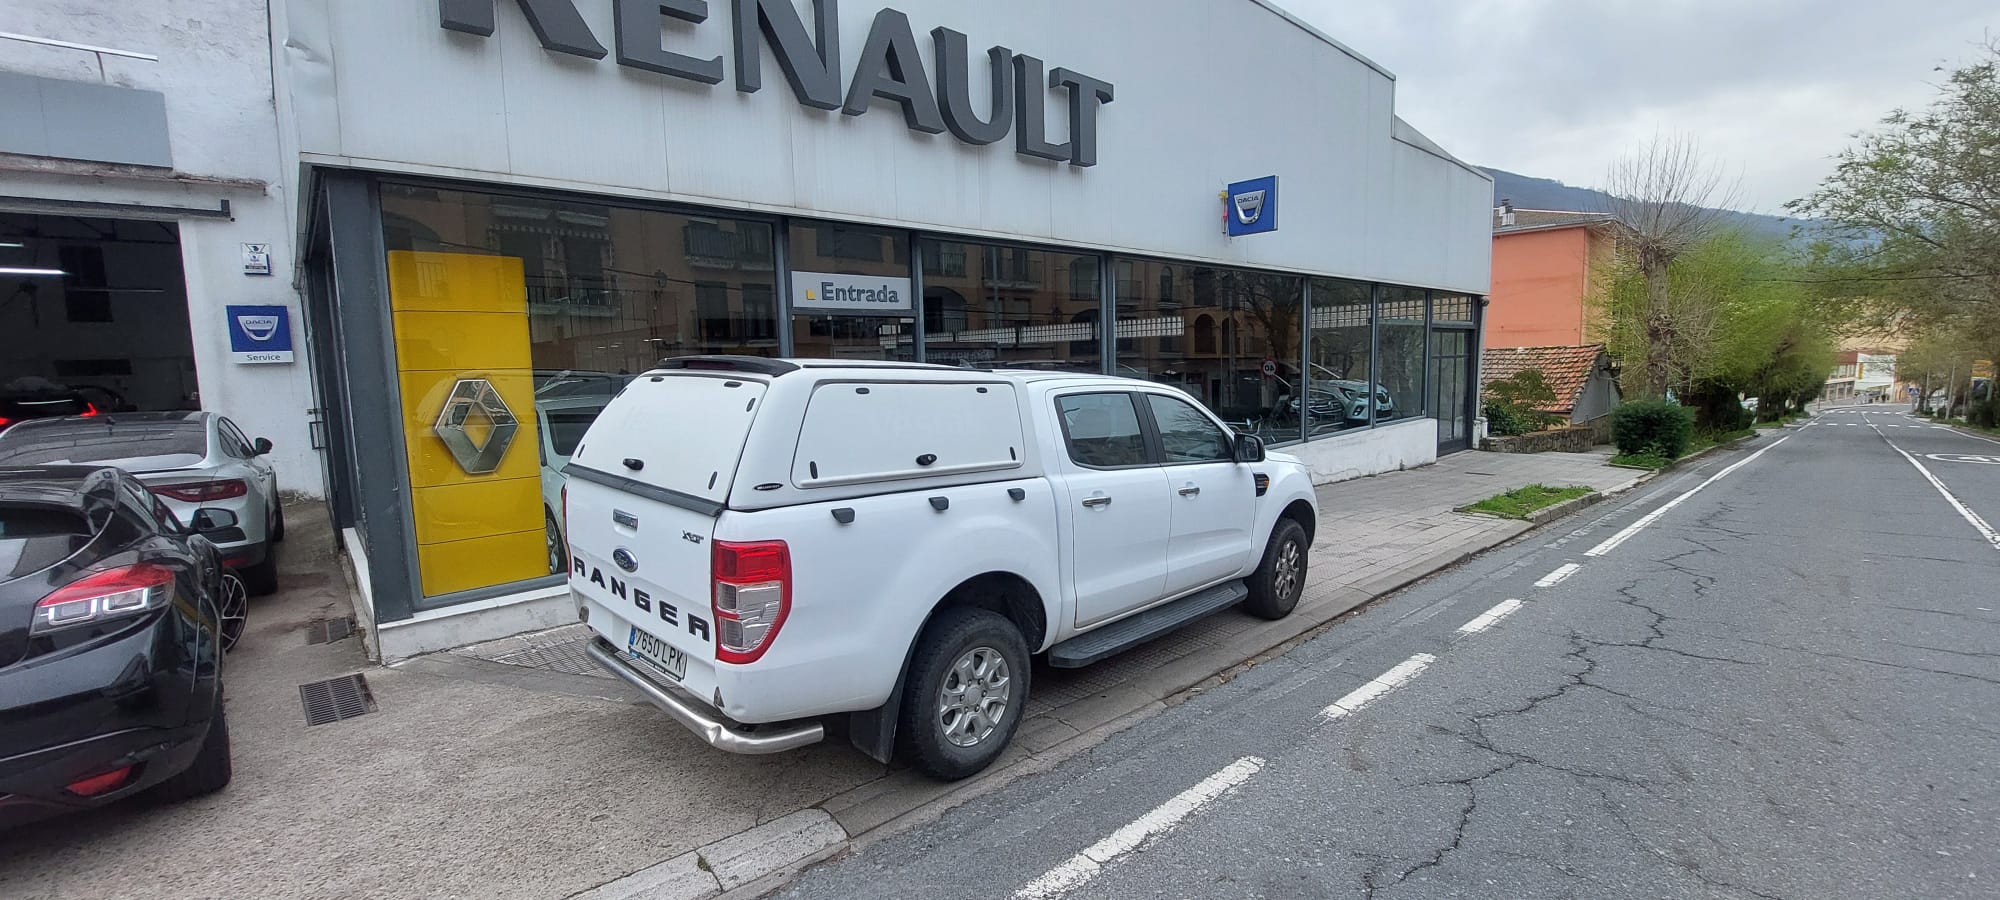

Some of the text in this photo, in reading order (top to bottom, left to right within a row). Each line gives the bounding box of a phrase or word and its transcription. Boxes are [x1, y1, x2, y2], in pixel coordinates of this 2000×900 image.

[1237, 195, 1259, 204] DACIA
[820, 281, 900, 303] Entrada
[246, 353, 281, 361] Service
[573, 555, 711, 643] RANGER
[635, 629, 660, 657] 7650
[661, 643, 684, 672] LPK
